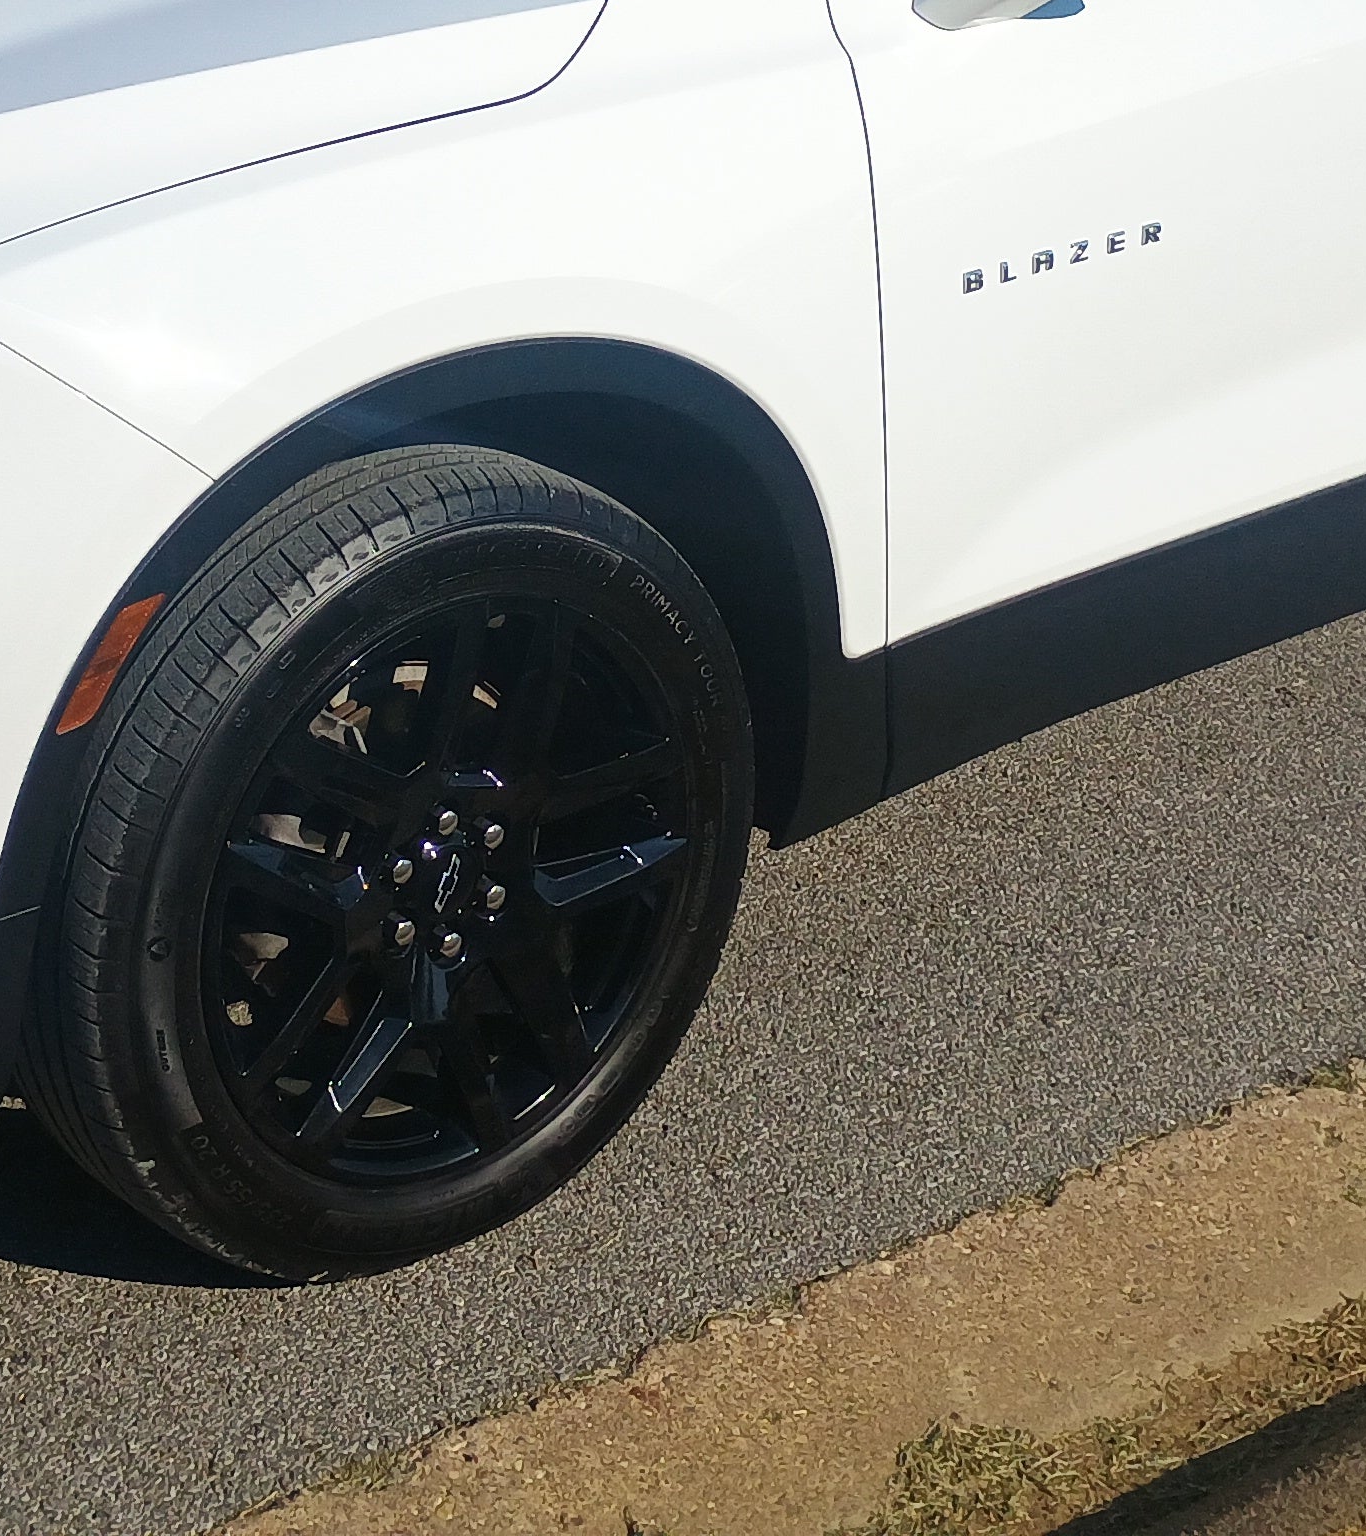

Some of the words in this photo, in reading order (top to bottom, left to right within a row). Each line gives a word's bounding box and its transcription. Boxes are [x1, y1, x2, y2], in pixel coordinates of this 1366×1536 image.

[962, 221, 1162, 295] BLAZER
[629, 573, 698, 646] PRIMACY
[692, 651, 724, 709] TOUR
